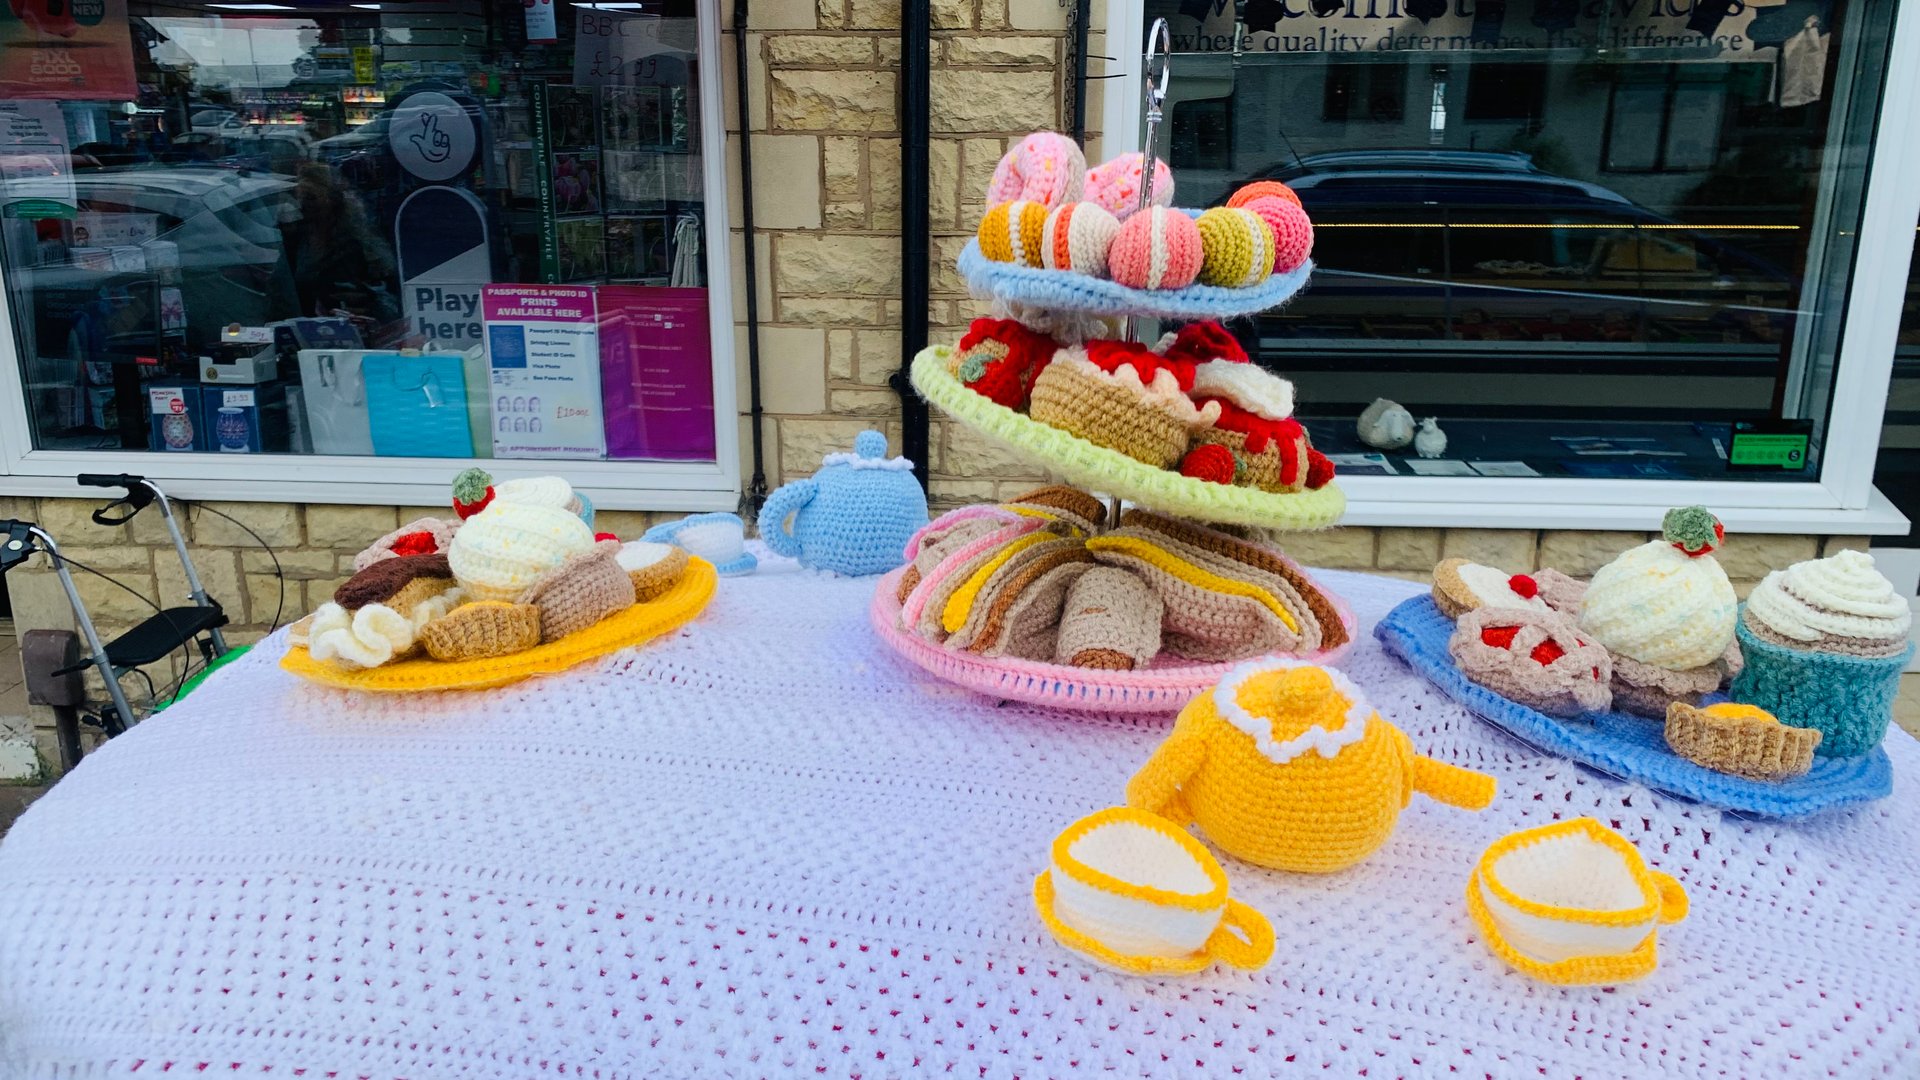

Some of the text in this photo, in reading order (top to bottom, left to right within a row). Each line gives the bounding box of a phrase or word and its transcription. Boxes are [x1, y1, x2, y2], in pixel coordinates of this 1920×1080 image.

[72, 4, 102, 16] NEW
[582, 14, 630, 37] BBC
[1170, 26, 1255, 51] where
[1264, 27, 1367, 51] quality
[533, 83, 547, 167] COUNTRYFILE
[540, 180, 553, 260] COUNTRYFILE
[416, 287, 480, 318] Play
[487, 288, 588, 298] PASSPORTS & PHOTO ID
[520, 297, 559, 307] PRINTS
[497, 307, 583, 318] AVAILABLE HERE
[418, 316, 483, 339] here
